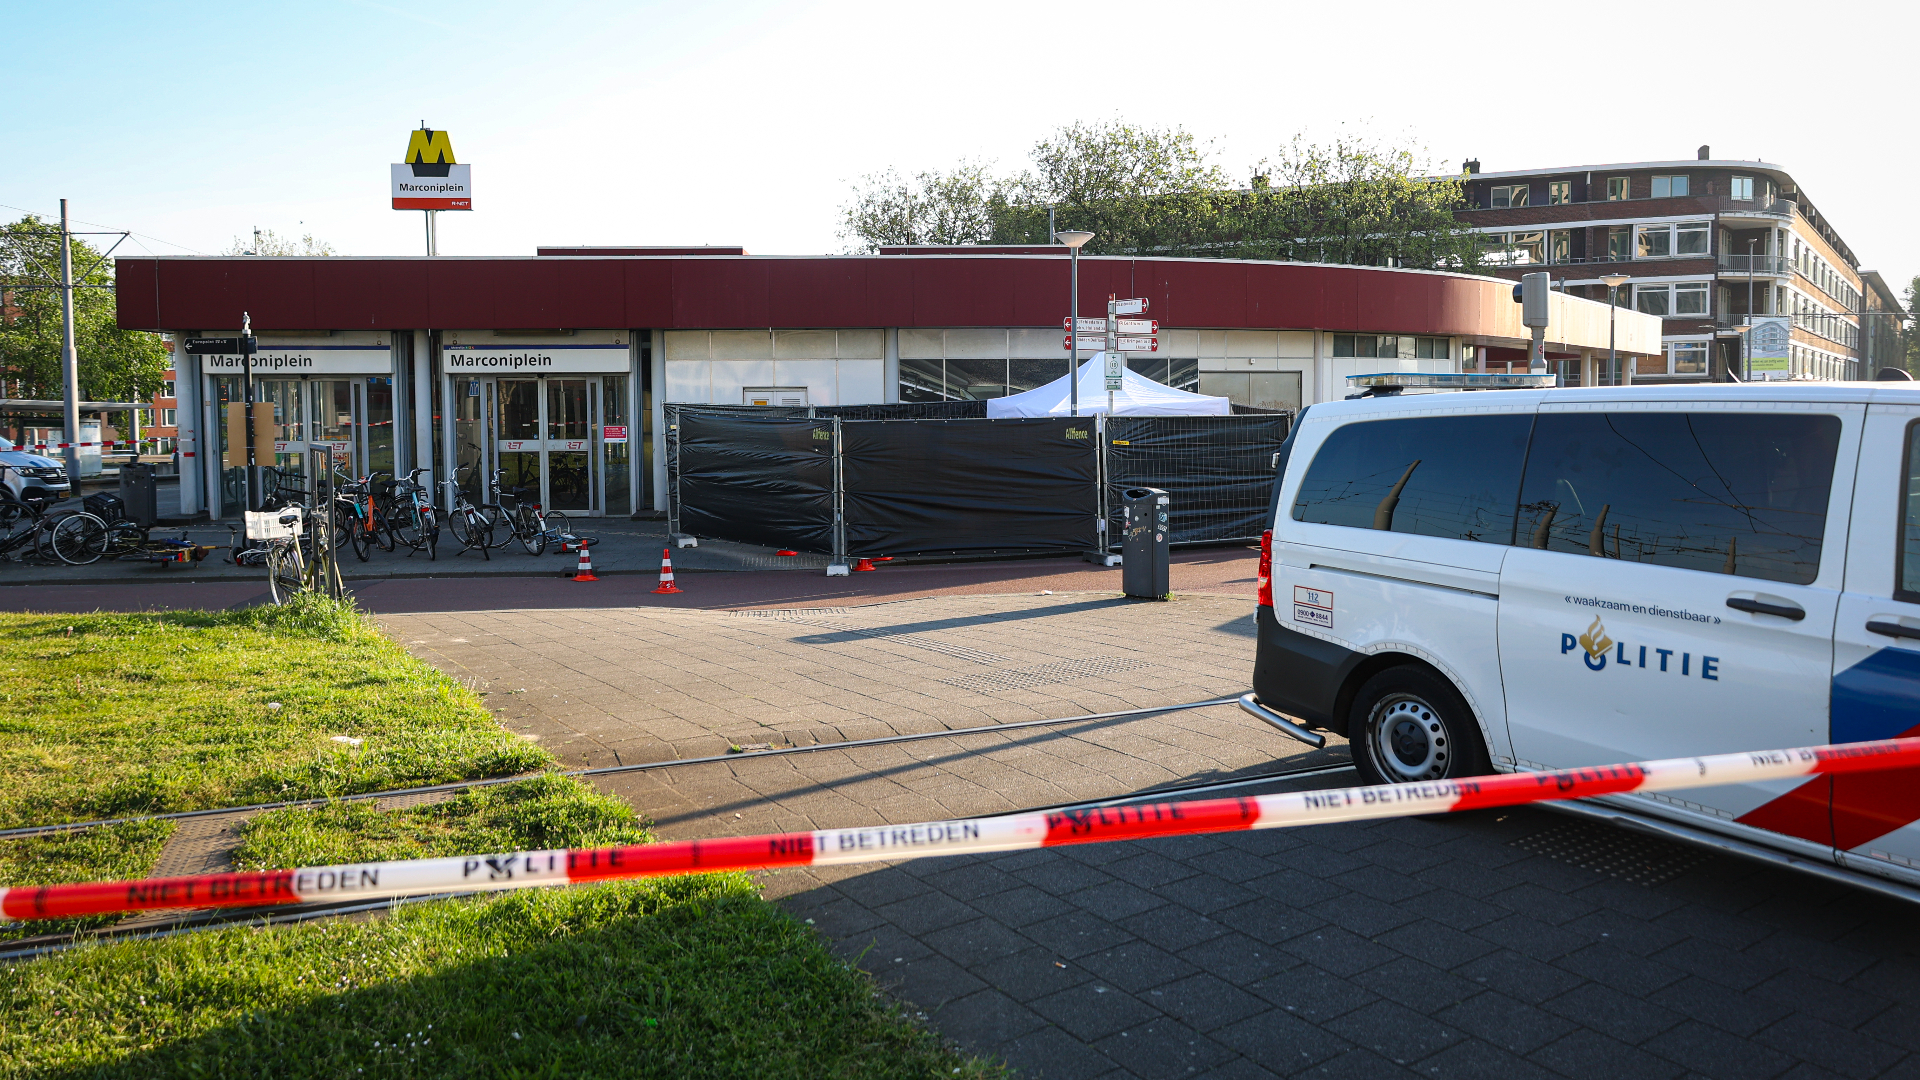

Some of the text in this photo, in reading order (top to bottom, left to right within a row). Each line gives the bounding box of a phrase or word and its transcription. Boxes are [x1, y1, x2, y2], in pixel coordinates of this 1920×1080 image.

[399, 183, 464, 194] Marconiplein
[450, 353, 552, 369] Marconiplein
[274, 443, 287, 451] ET
[505, 441, 523, 450] RET
[565, 441, 584, 450] RET
[1307, 591, 1319, 601] 112
[1573, 596, 1631, 612] waakzaam
[1632, 604, 1647, 614] en
[1648, 604, 1711, 624] dienstbaar
[1560, 632, 1720, 681] POLITIE
[1303, 790, 1351, 809] NIET
[769, 820, 979, 855] NIET BETREDEN
[128, 868, 380, 905] NIET BETREDEN
